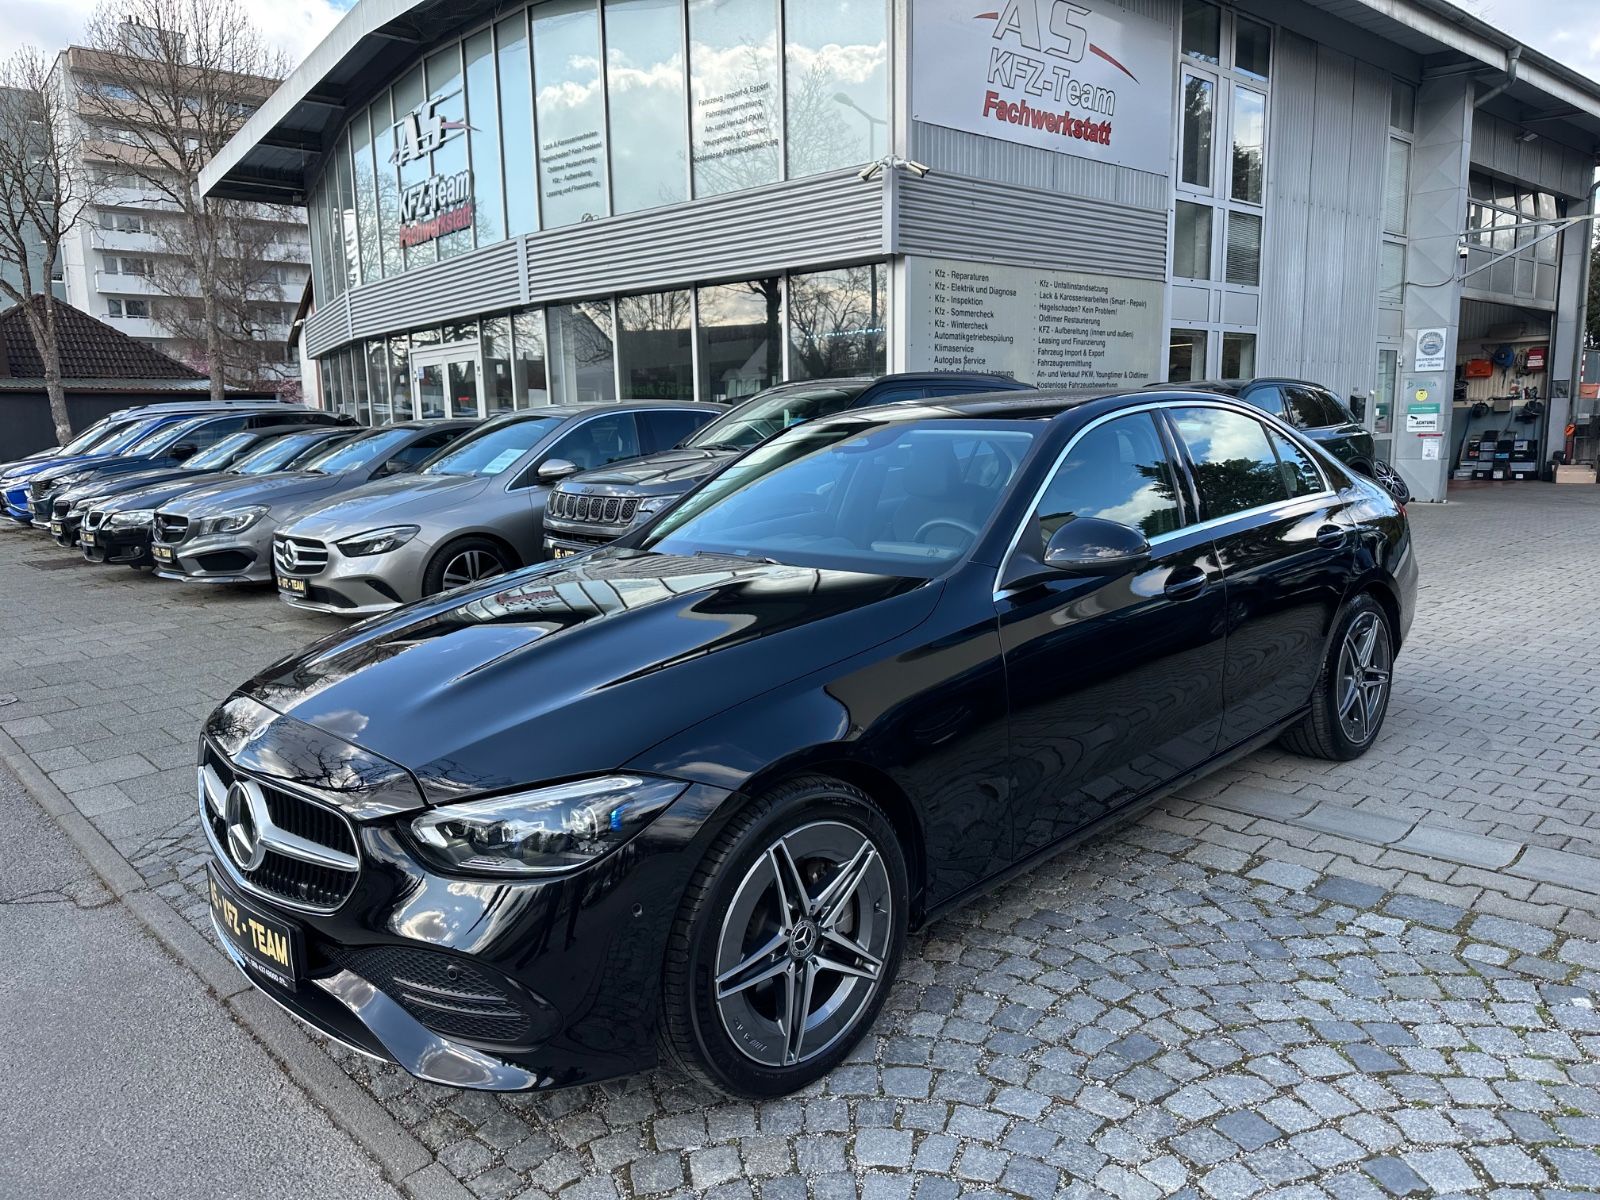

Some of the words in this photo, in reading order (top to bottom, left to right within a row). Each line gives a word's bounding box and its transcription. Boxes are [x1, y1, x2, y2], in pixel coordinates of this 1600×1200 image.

[992, 0, 1092, 63] AS
[750, 82, 769, 93] Export
[987, 47, 1116, 116] KFZ-Team
[982, 90, 1112, 145] Fachwerkstatt
[392, 94, 446, 167] AS
[399, 169, 474, 225] KFZ-Team
[399, 202, 474, 248] Fachwerkstatt
[935, 269, 945, 278] Kfz
[951, 270, 989, 282] Reparaturen
[935, 282, 945, 290] Kfz
[951, 283, 974, 293] Elektrik
[976, 286, 988, 294] und
[989, 287, 1017, 297] Diagnose
[1039, 280, 1049, 288] Kfz
[1053, 281, 1108, 294] Unfallinstandsetzung
[935, 294, 945, 303] Kfz
[951, 296, 983, 306] Inspektion
[1039, 291, 1052, 299] Lack
[1060, 293, 1108, 304] Karosseriearbeiten
[935, 307, 945, 315] Kfz
[951, 308, 994, 318] Sommercheck
[1039, 303, 1081, 313] Hagelschaden?
[1095, 307, 1118, 315] Problem!
[935, 319, 945, 328] Kfz
[951, 321, 988, 330] Wintercheck
[1039, 314, 1063, 323] Oldtimer
[1064, 316, 1101, 326] Restaurierung
[934, 331, 1014, 344] Automatikgetriebespülung
[1054, 326, 1089, 337] Aufbereitung
[934, 344, 974, 352] Klimaservice
[1038, 338, 1060, 347] Leasing
[1073, 338, 1106, 348] Finanzierung
[1038, 348, 1063, 357] Fahrzeug
[1065, 348, 1082, 357] Import
[1088, 349, 1105, 358] Export
[934, 355, 962, 365] Autoglas
[963, 356, 986, 364] Service
[1037, 359, 1092, 368] Fahrzeugvermittlung
[1036, 381, 1067, 389] Kostenlose
[222, 896, 241, 936] KFZ
[248, 918, 289, 967] TEAM
